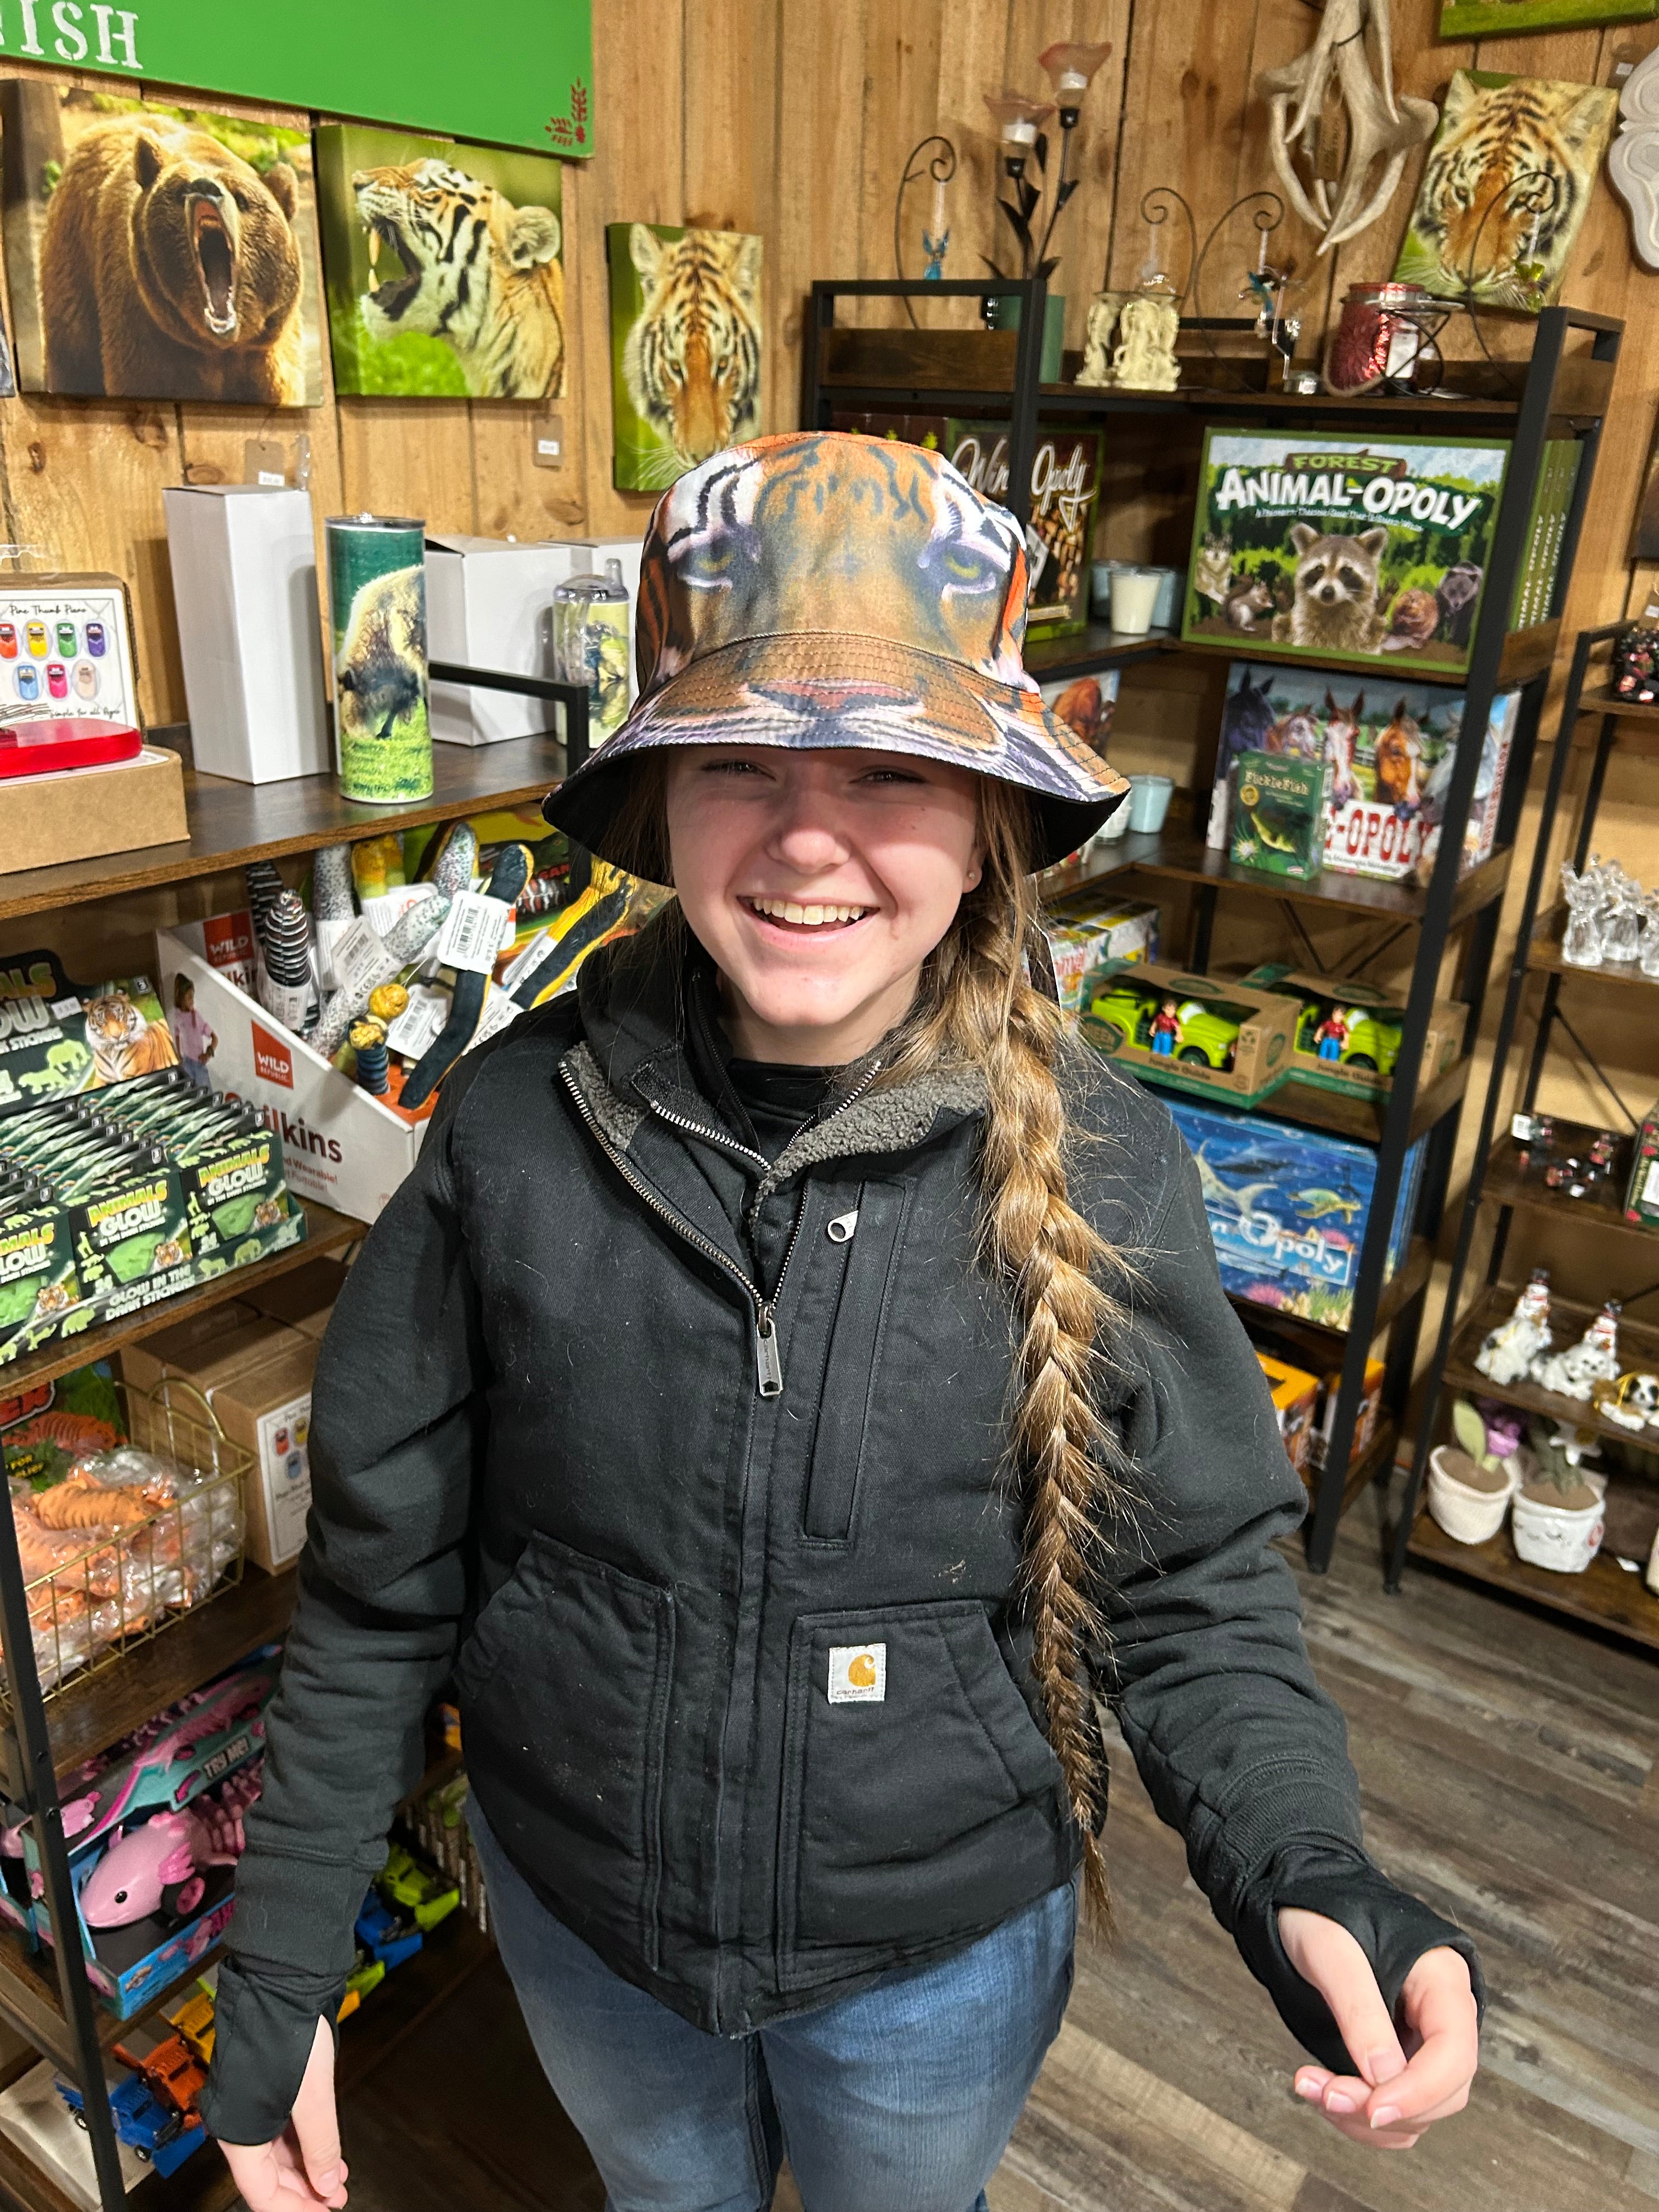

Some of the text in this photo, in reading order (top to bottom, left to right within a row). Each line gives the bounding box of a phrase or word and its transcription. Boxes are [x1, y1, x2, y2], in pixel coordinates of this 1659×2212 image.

[0, 0, 143, 69] ISH
[1293, 455, 1398, 473] FOREST
[1216, 467, 1481, 531] ANIMAL-OPOLY
[210, 936, 249, 955] WILD
[257, 1052, 290, 1073] WILD
[198, 1143, 270, 1189] ANIMALS
[208, 1161, 264, 1197] GLOW
[87, 1180, 168, 1228] ANIMALS
[99, 1199, 161, 1235] GLOW
[110, 1264, 191, 1307] GLOW IN THE
[836, 1686, 874, 1695] carhartt
[203, 1752, 227, 1778] TRY
